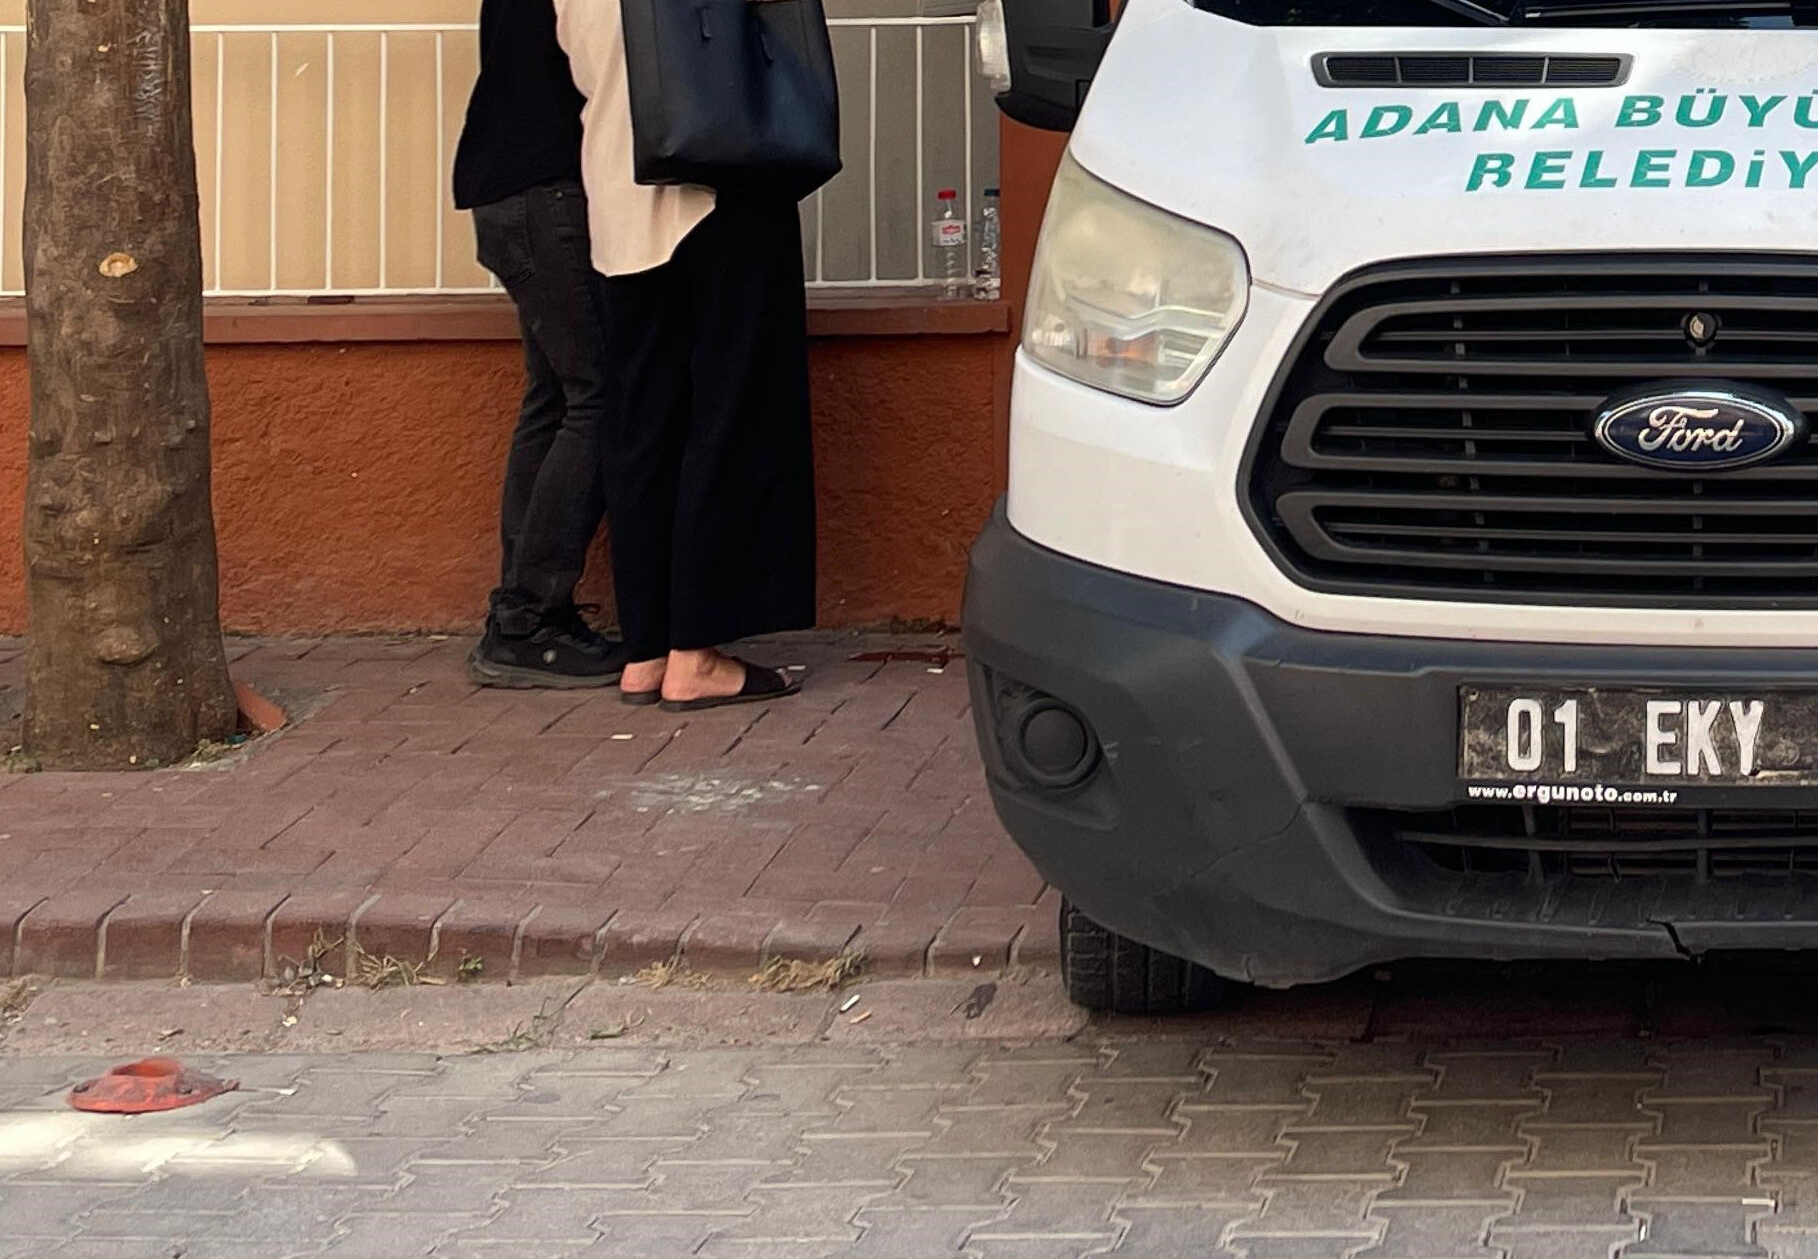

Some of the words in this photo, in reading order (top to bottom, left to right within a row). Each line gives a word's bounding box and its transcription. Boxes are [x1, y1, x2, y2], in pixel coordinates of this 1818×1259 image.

[1305, 97, 1580, 145] ADANA
[1638, 405, 1746, 453] Ford
[1506, 698, 1579, 773] 01
[1645, 699, 1764, 776] EKY
[1468, 784, 1678, 804] www.ergunoto.com.tr
